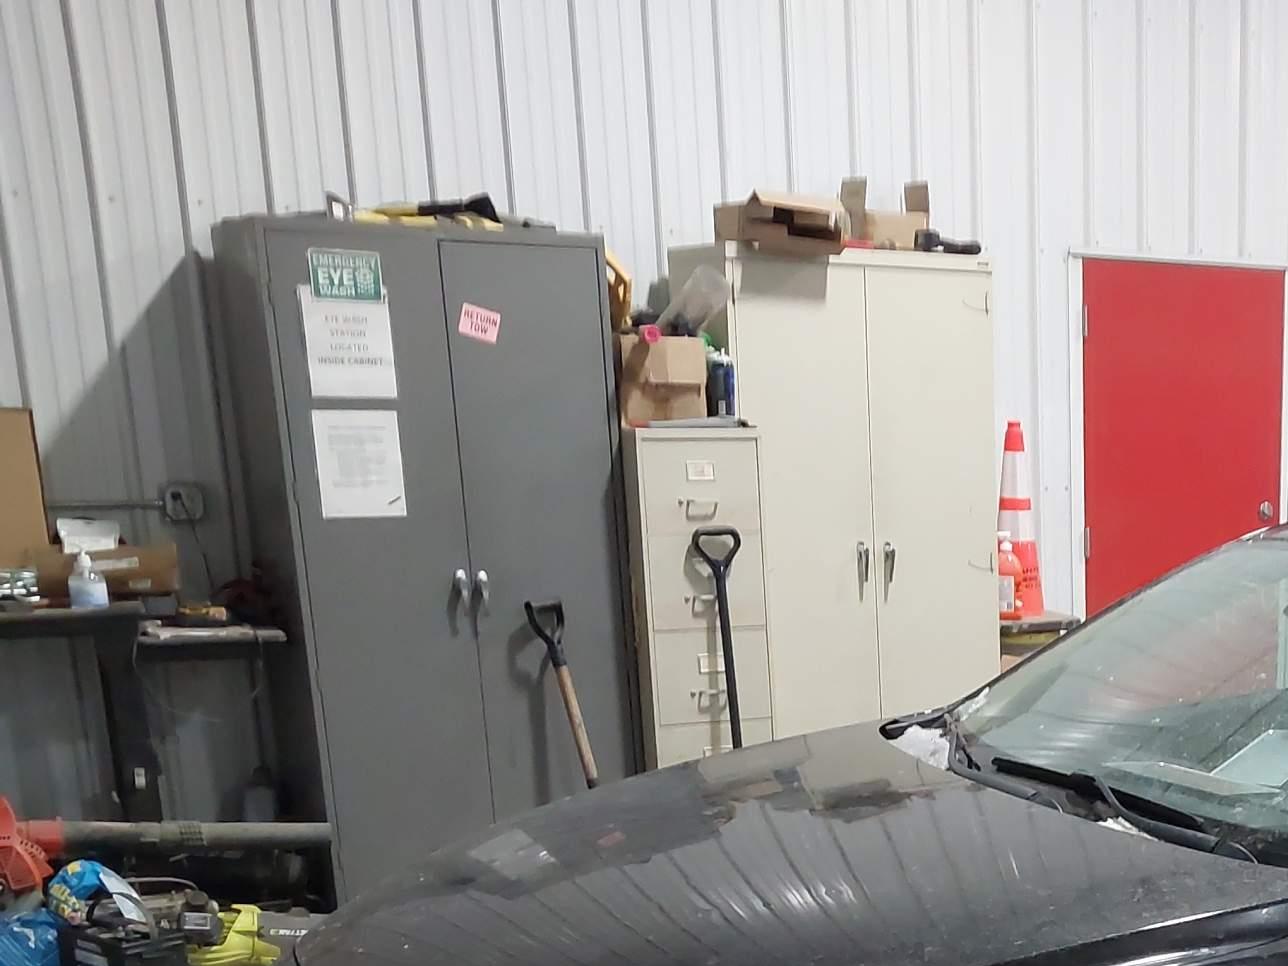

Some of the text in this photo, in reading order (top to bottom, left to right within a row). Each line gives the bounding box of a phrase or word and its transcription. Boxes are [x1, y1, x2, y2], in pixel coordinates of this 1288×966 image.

[317, 267, 355, 286] EYE
[319, 284, 356, 297] WASH
[463, 309, 498, 329] RETURN
[329, 329, 367, 338] STATION
[470, 321, 489, 335] TOW
